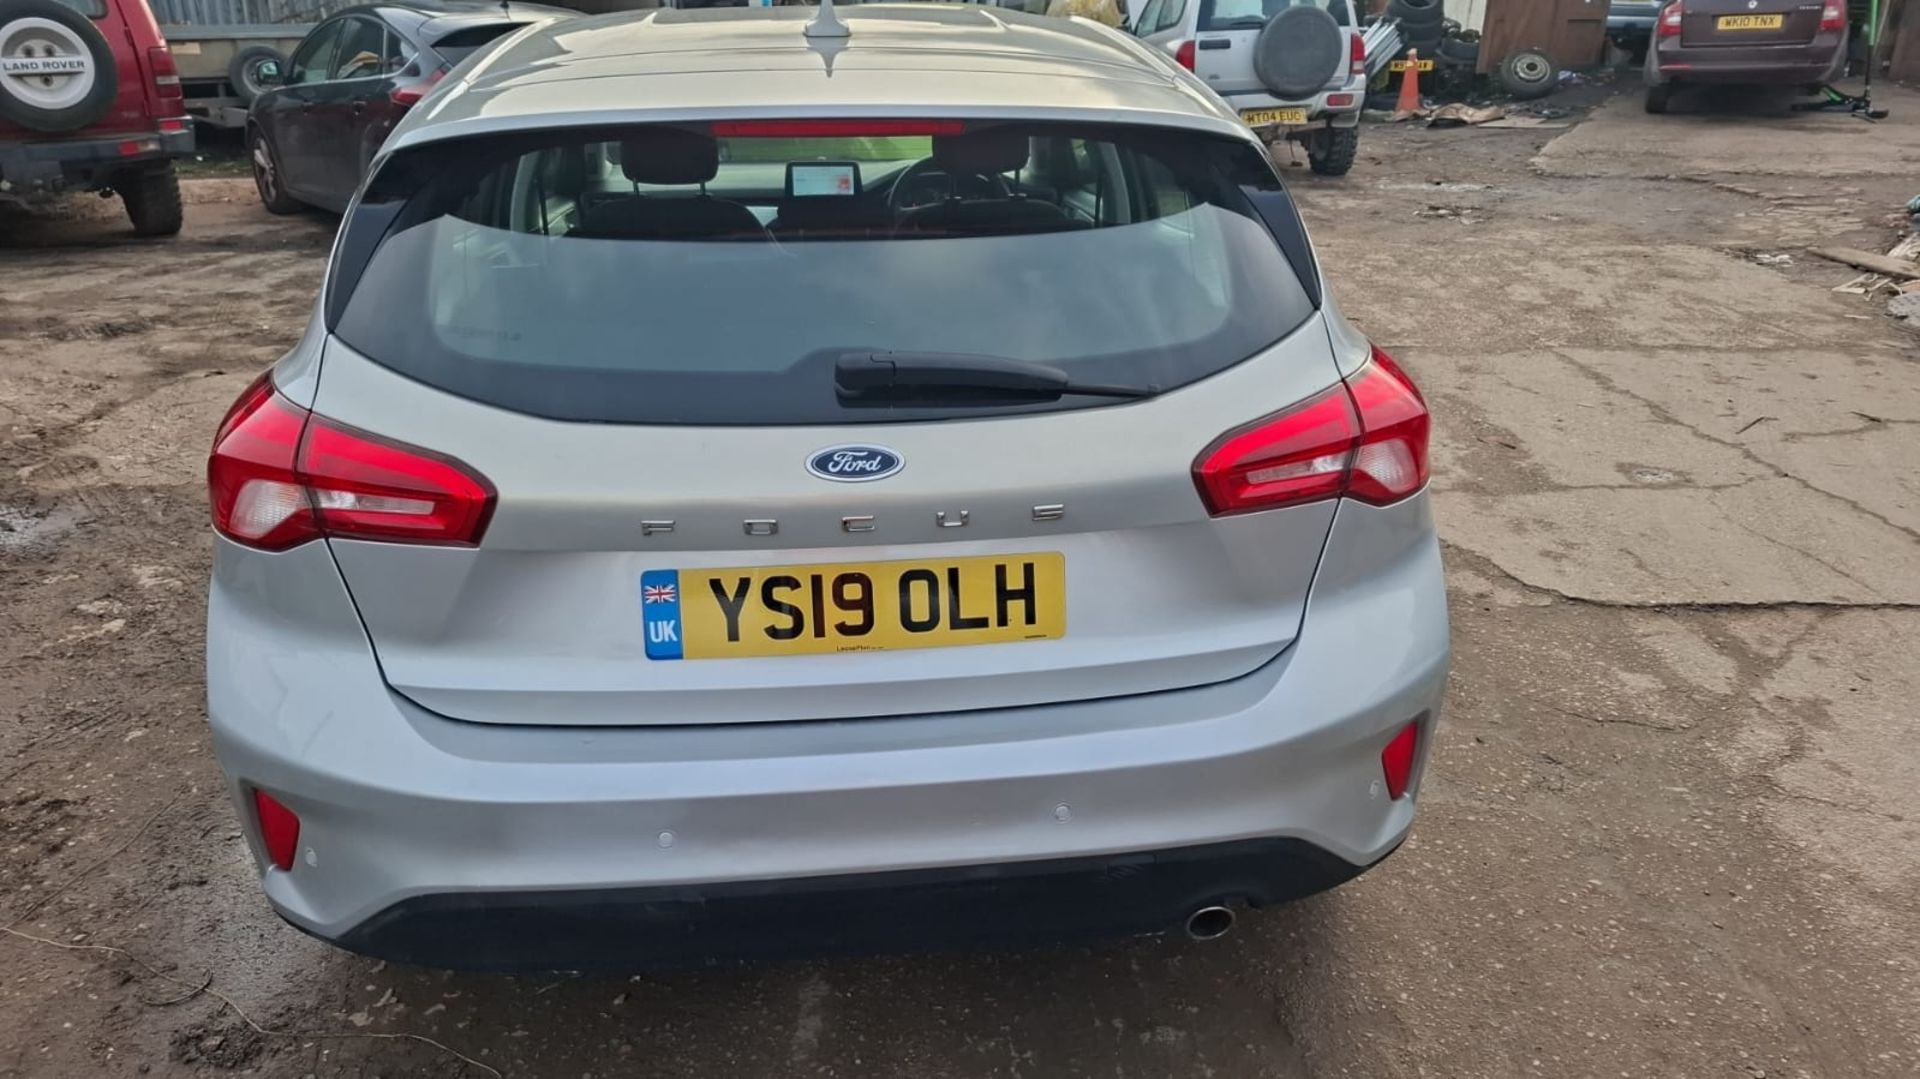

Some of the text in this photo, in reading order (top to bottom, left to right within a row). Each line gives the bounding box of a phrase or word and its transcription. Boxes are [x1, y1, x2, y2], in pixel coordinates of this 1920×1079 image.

[1754, 16, 1776, 26] TNX
[3, 60, 85, 71] LAND ROVER
[827, 450, 882, 473] Ford
[640, 503, 1065, 536] FOCUS
[709, 562, 1036, 643] YS19 OLH
[649, 620, 678, 643] UK
